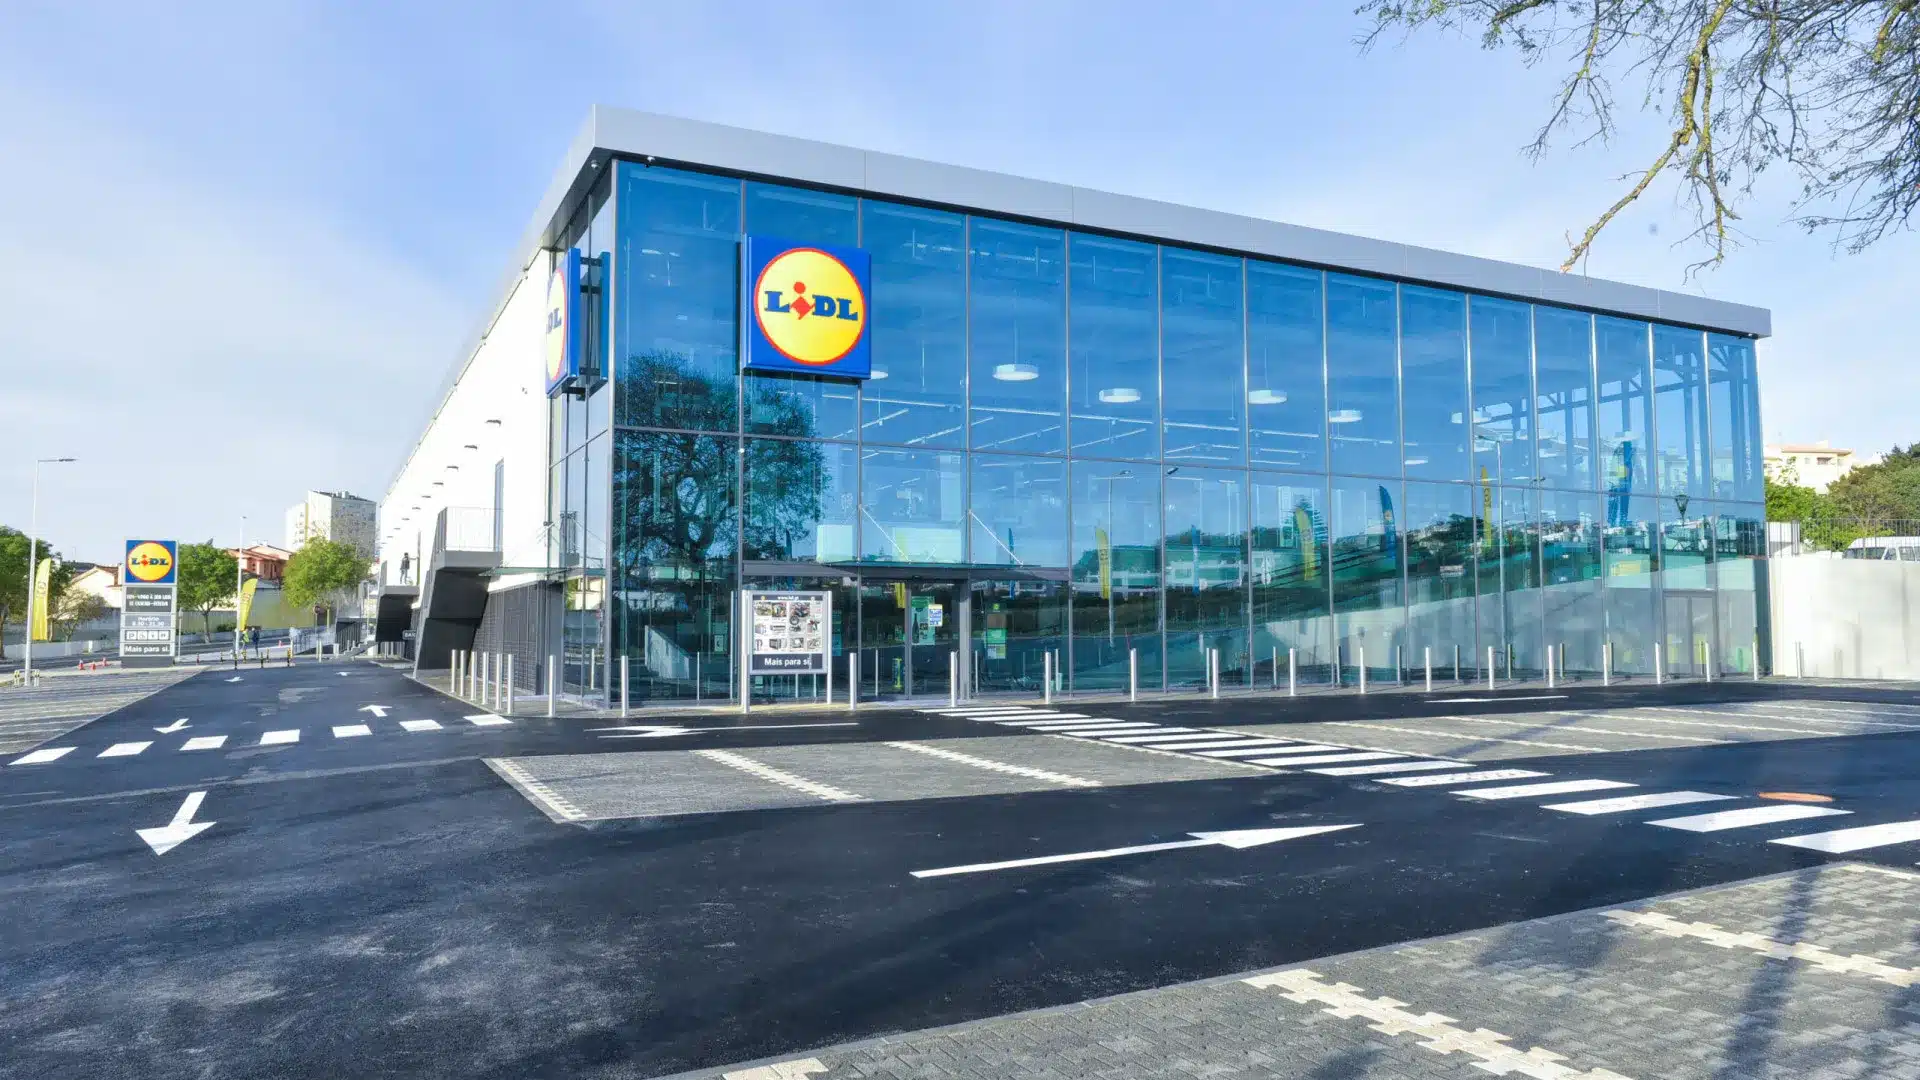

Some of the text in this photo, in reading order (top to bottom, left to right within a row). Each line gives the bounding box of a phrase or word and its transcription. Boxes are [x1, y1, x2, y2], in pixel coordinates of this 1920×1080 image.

[546, 307, 562, 334] DL
[125, 645, 142, 653] Mais
[143, 647, 160, 655] para
[764, 657, 783, 666] Mais
[784, 659, 802, 667] para
